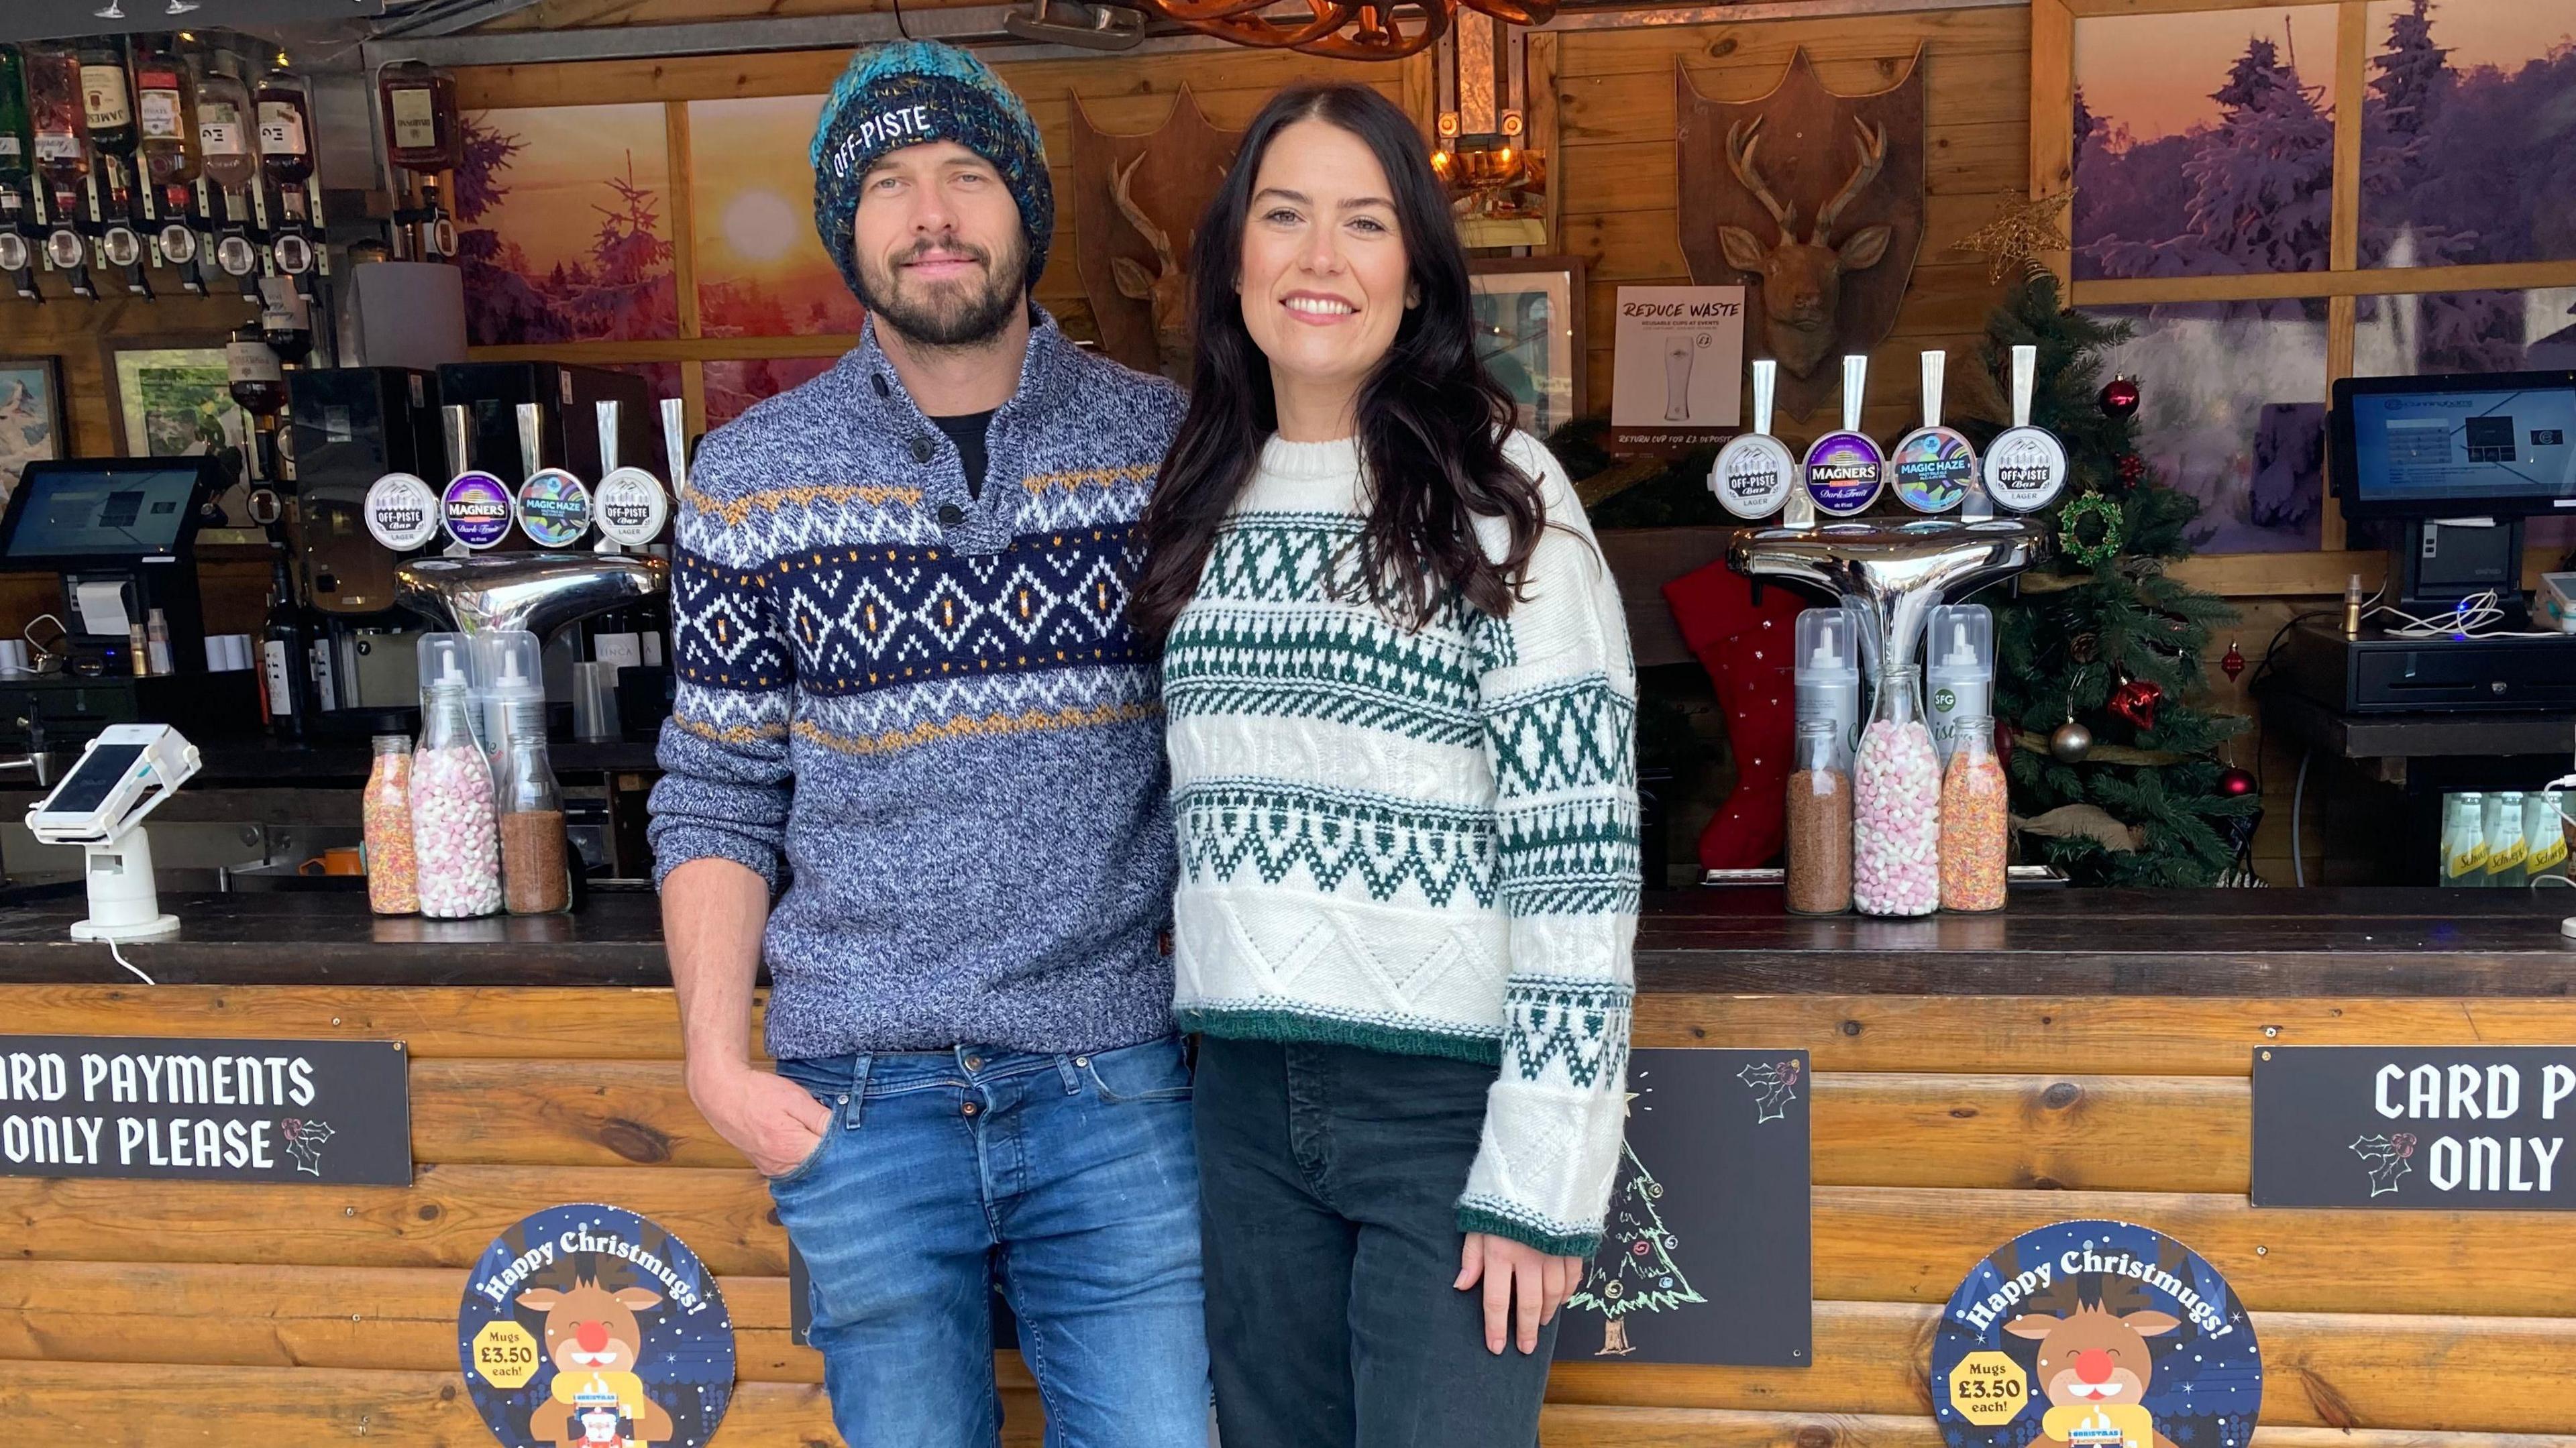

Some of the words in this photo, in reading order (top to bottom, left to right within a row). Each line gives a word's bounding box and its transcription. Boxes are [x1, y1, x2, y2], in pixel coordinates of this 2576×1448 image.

[834, 106, 930, 178] OFF-PISTE
[1623, 302, 1686, 317] REDUCE
[1690, 302, 1741, 317] WASTE
[1618, 435, 1651, 443] RETURN
[1652, 435, 1667, 443] CUP
[1668, 435, 1684, 443] FOR
[1812, 465, 1876, 480] MAGNERS
[1901, 463, 1935, 474] MAGIC
[1936, 459, 1966, 471] HAZE
[2001, 469, 2047, 481] OFF-PISTE
[1731, 474, 1775, 489] OFF-PISTE
[1820, 489, 1842, 499] Dark
[1843, 488, 1868, 498] Fruit
[526, 499, 555, 510] MAGIC
[556, 501, 581, 512] HAZE
[1743, 498, 1768, 506] LAGER
[449, 504, 505, 516] MAGNERS
[607, 507, 647, 518] OFF-PISTE
[378, 511, 421, 522] OFF-PISTE
[457, 524, 477, 533] Dark
[478, 524, 500, 535] Fruit
[360, 644, 367, 653] 7
[1935, 695, 1954, 705] SFG
[0, 1052, 66, 1101] RD
[80, 1052, 315, 1107] PAYMENTS
[2375, 1063, 2520, 1120] CARD
[3, 1114, 103, 1164] ONLY
[116, 1117, 274, 1169] PLEASE
[2428, 1135, 2564, 1192] ONLY
[484, 1241, 553, 1303] Happy
[560, 1231, 707, 1316] Christmugs!
[1966, 1261, 2051, 1331] Happy
[2060, 1249, 2233, 1340] Christmugs!
[489, 1332, 520, 1343] Mugs
[481, 1347, 532, 1363] £3.50
[492, 1367, 522, 1376] each!
[1970, 1363, 2006, 1375] Mugs
[1958, 1380, 2021, 1398] £3.50
[1972, 1400, 2008, 1412] each!
